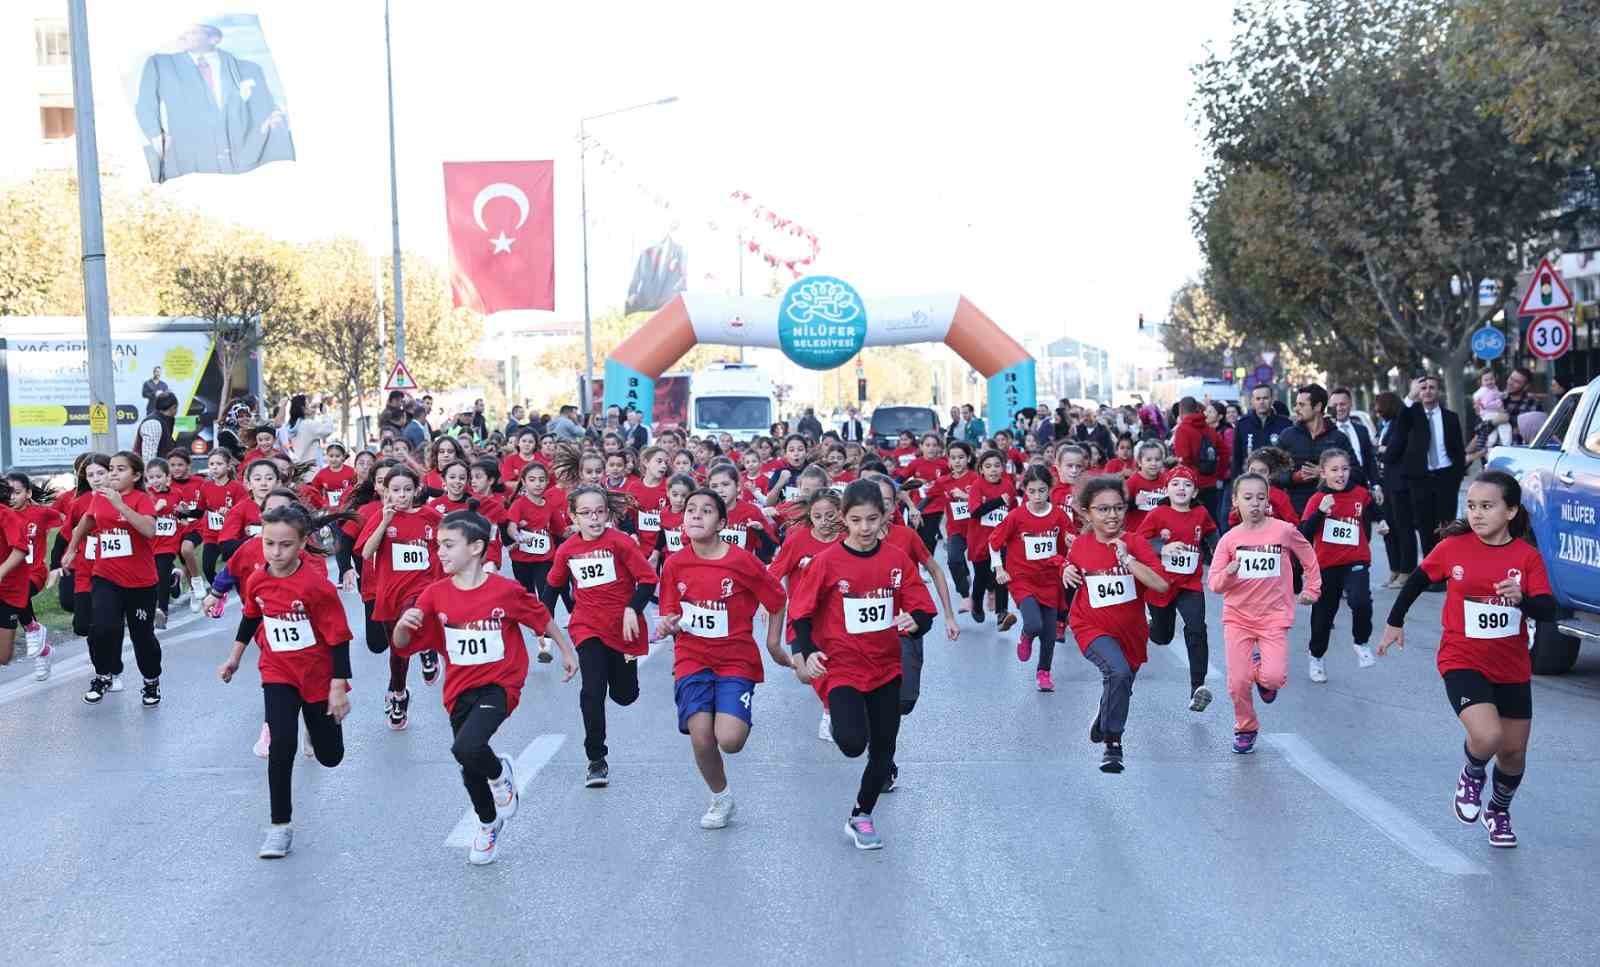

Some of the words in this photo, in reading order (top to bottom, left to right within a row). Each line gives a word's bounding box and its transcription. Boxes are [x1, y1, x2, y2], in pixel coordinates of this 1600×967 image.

[793, 323, 856, 337] NİLÜFER
[1536, 326, 1563, 347] 30
[19, 436, 58, 447] Neskar
[61, 435, 88, 448] Opel
[1561, 499, 1596, 525] NİLÜFER
[1332, 526, 1352, 538] 862
[669, 534, 681, 546] 40
[1033, 541, 1053, 554] 979
[403, 551, 423, 563] 801
[1170, 555, 1191, 567] 991
[1244, 557, 1275, 571] 1420
[580, 563, 605, 580] 392
[1097, 580, 1125, 599] 940
[857, 604, 886, 623] 397
[1478, 612, 1509, 629] 990
[272, 627, 300, 643] 113
[457, 637, 488, 656] 701
